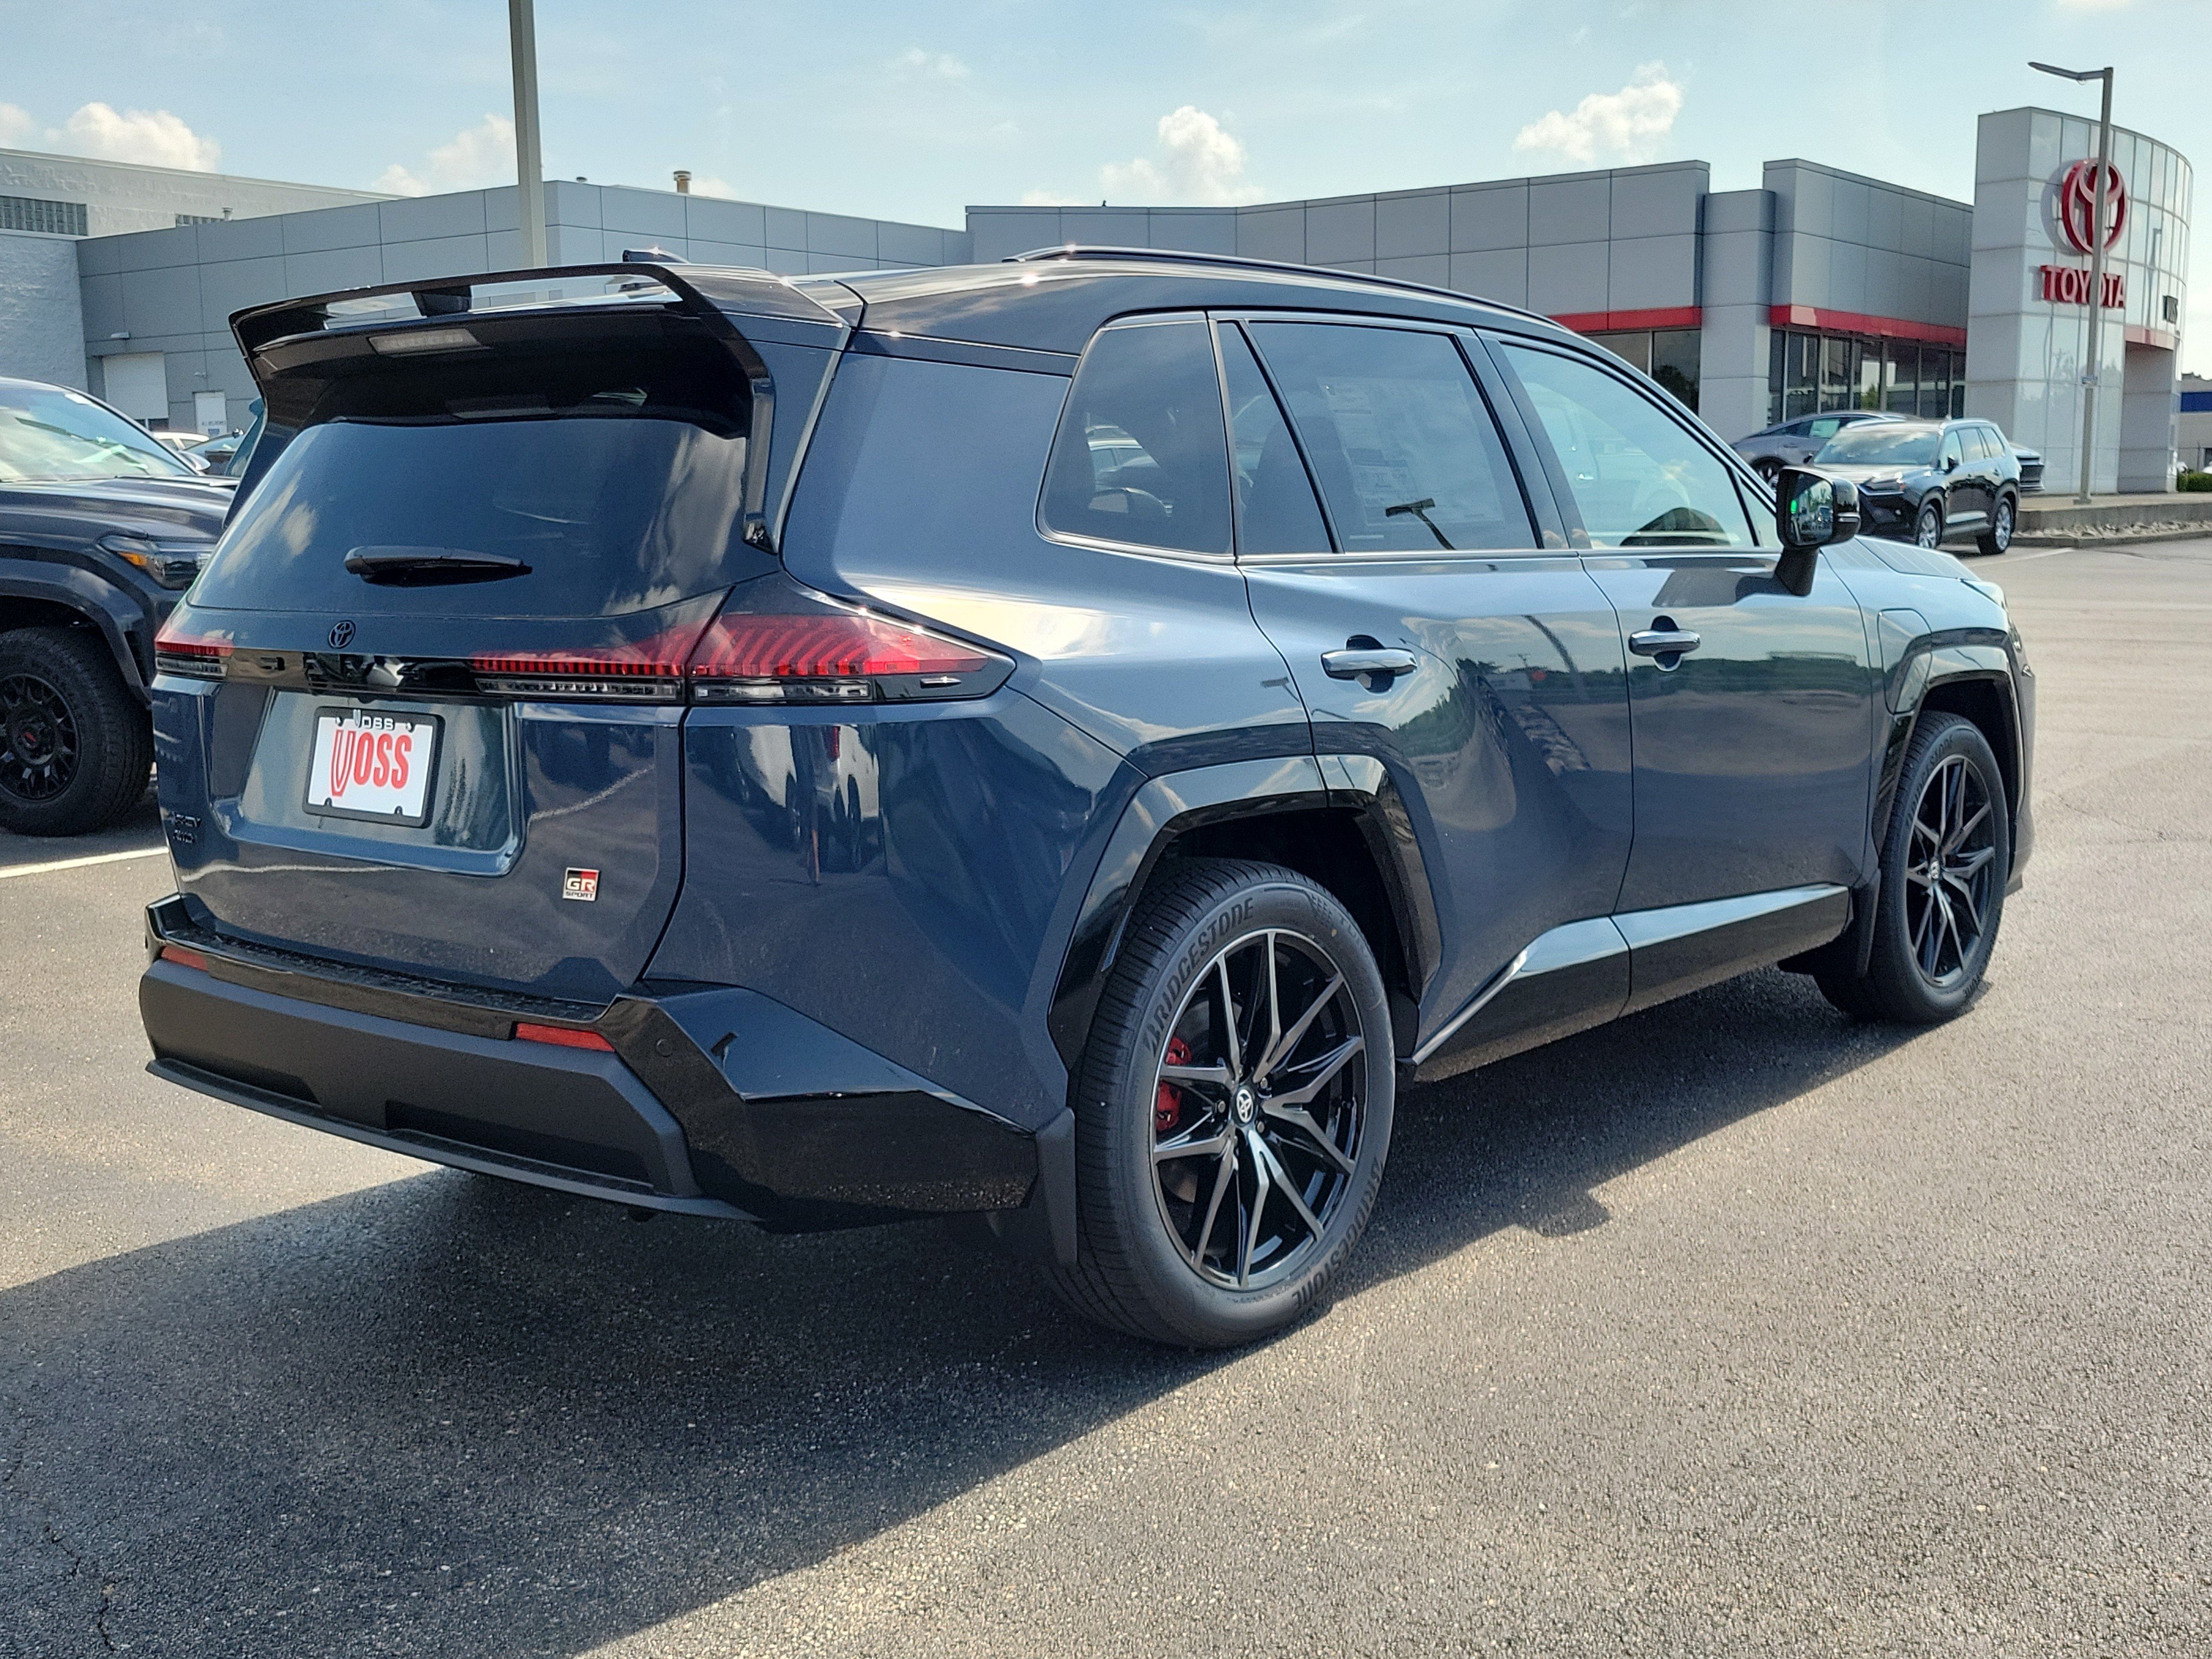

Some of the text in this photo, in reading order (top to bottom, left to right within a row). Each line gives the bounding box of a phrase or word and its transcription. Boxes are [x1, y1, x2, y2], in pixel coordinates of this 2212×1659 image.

[353, 709, 394, 731] VOSS
[331, 729, 413, 797] VOSS
[567, 878, 596, 893] GR
[1144, 896, 1254, 1058] BRIDGESTONE
